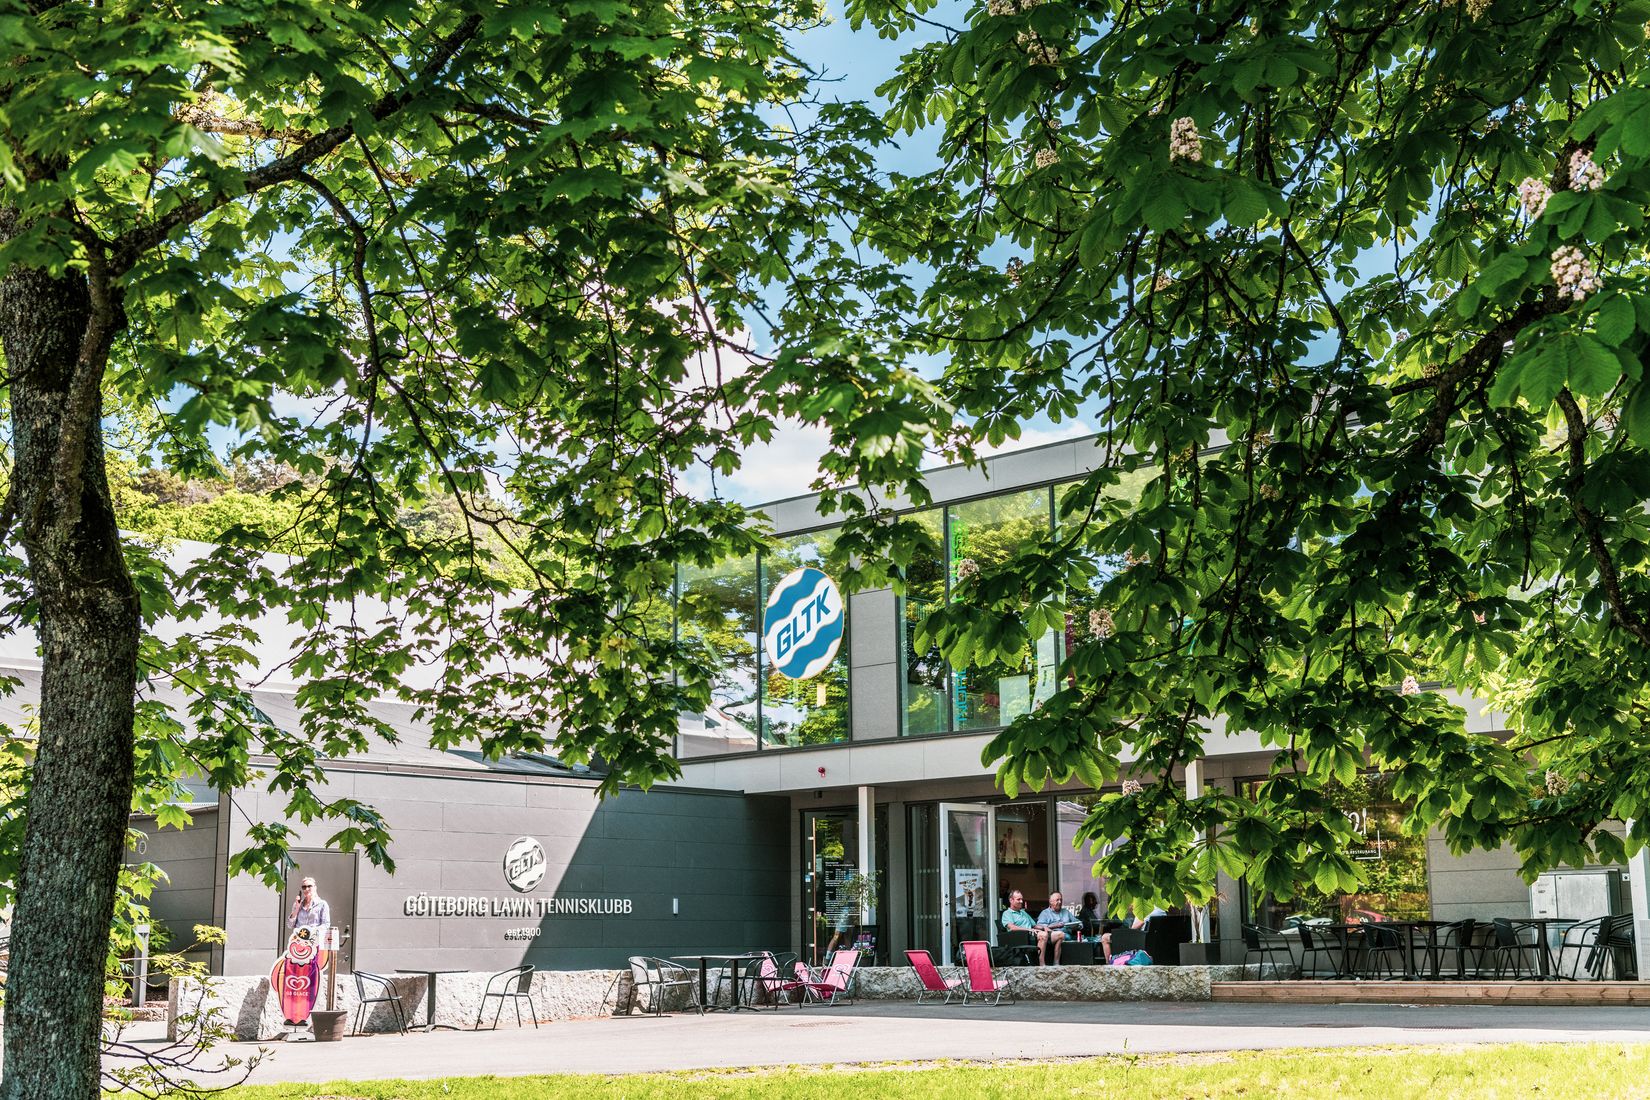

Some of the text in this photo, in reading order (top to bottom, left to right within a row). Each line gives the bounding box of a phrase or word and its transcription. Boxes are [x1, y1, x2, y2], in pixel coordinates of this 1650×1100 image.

[776, 586, 831, 660] GLTK
[510, 847, 542, 880] GLTK
[405, 892, 633, 915] GÖTEBORG LAWN TENNISKLUBB
